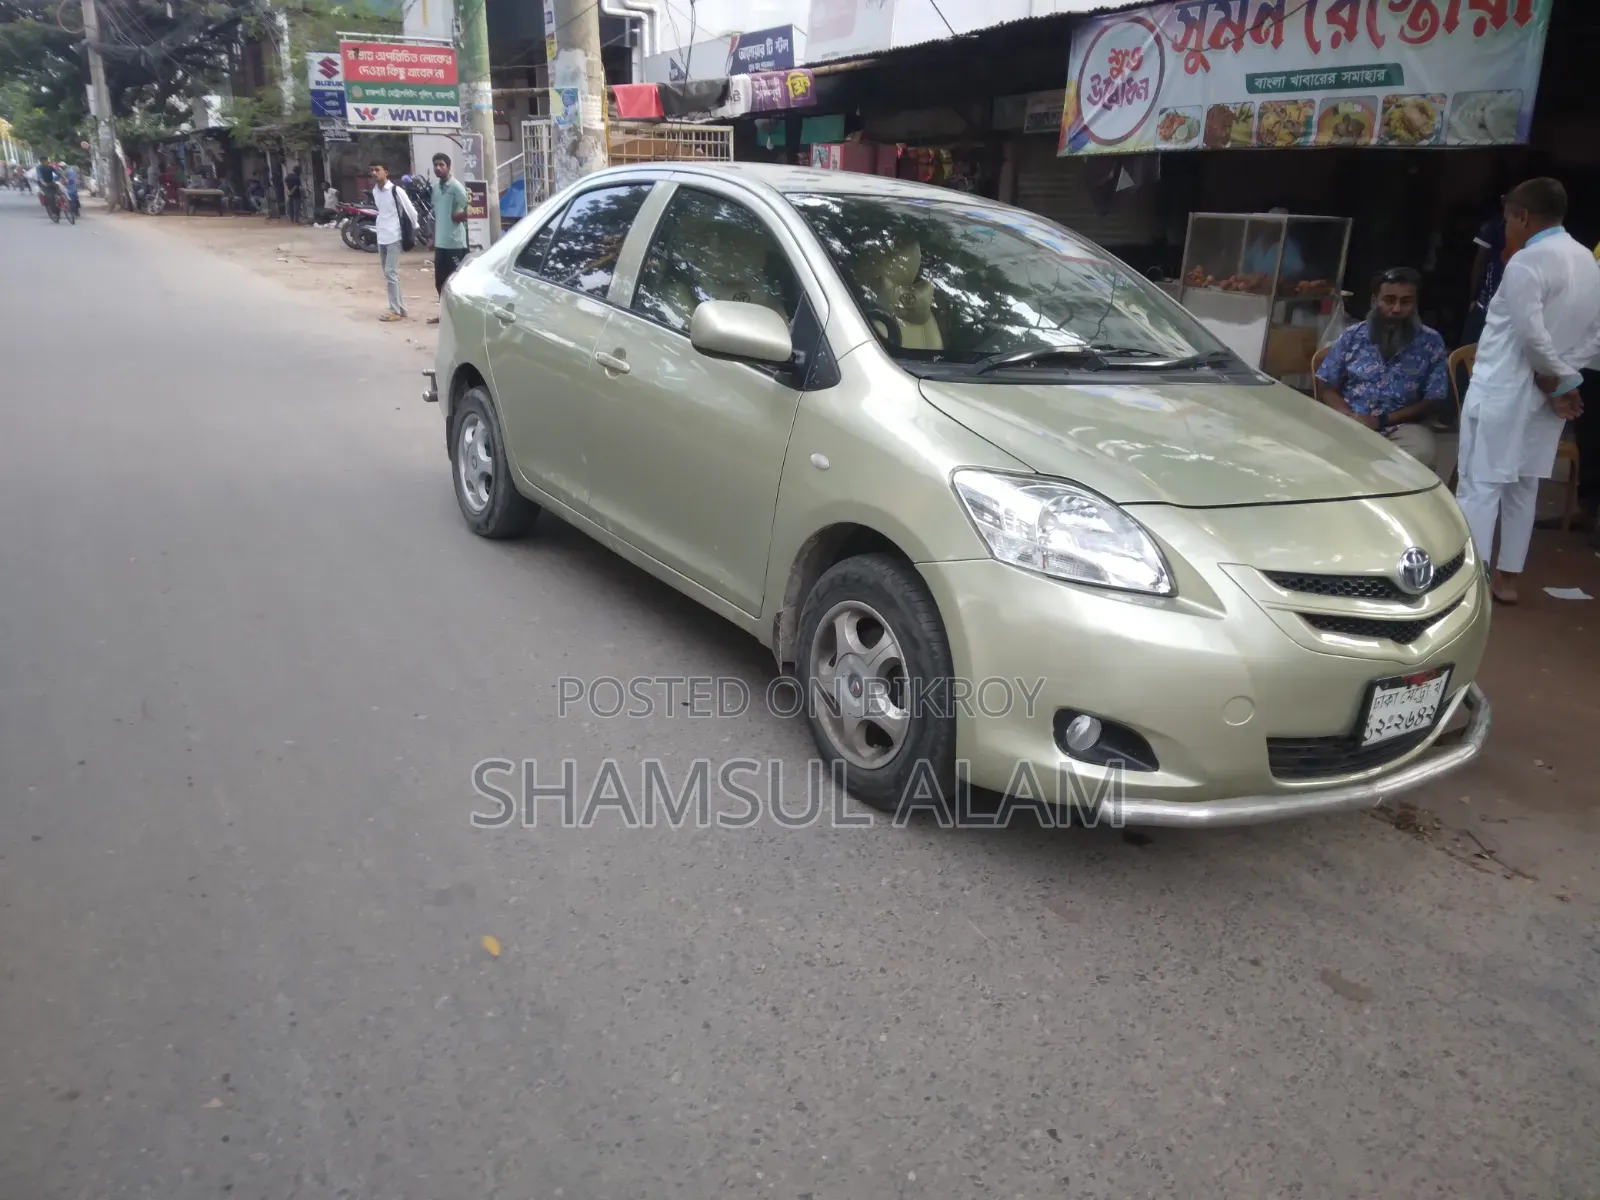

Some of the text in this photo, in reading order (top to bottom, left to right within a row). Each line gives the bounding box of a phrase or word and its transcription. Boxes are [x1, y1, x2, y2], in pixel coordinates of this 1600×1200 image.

[1171, 0, 1286, 76] সুমন
[375, 49, 418, 63] অপরিচিত
[419, 53, 453, 65] লোকের
[1108, 46, 1144, 80] শুভ
[358, 64, 445, 81] দেওয়া কিছু খাবেন না
[1254, 69, 1388, 89] বাংলা খাবারের সমাহার
[1086, 73, 1150, 111] উদ্বোধন
[388, 108, 459, 124] WALTON
